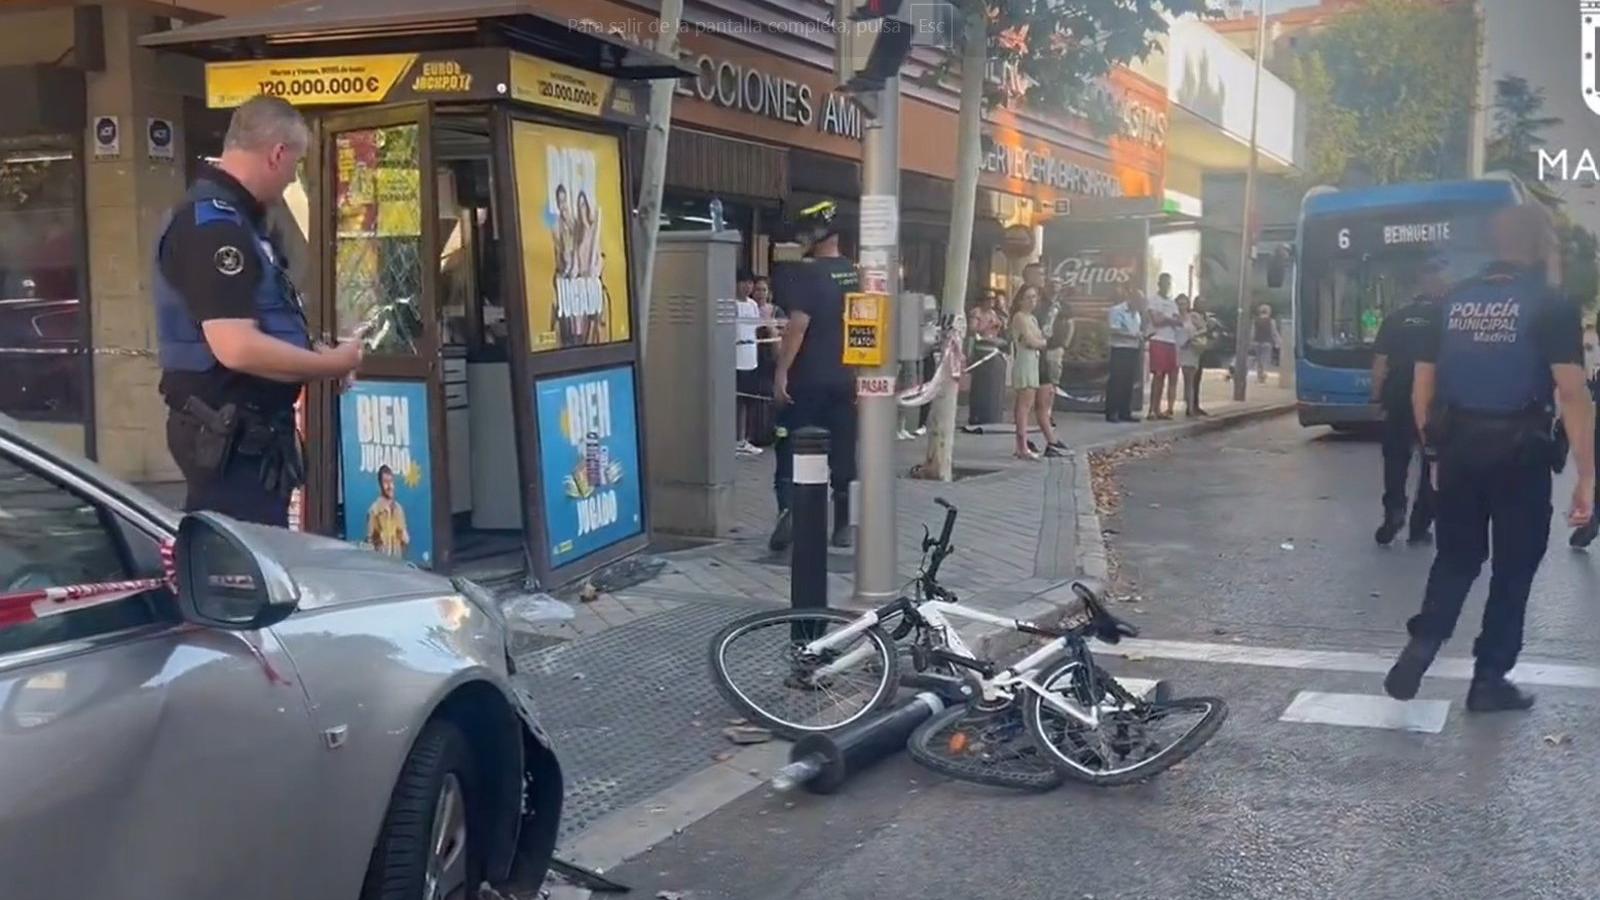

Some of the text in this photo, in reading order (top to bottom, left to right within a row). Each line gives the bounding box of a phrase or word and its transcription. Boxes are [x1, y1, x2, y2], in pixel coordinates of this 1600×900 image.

[1338, 222, 1451, 249] 6 BENAVENTE
[1449, 298, 1521, 318] POLICÍA
[1448, 316, 1518, 331] MUNICIPAL
[1473, 331, 1517, 344] Madrid
[860, 379, 889, 394] PASAR
[356, 393, 410, 446] BIEN
[565, 379, 613, 457] BIEN
[360, 441, 413, 476] JUGADO
[576, 489, 618, 538] JUGADO
